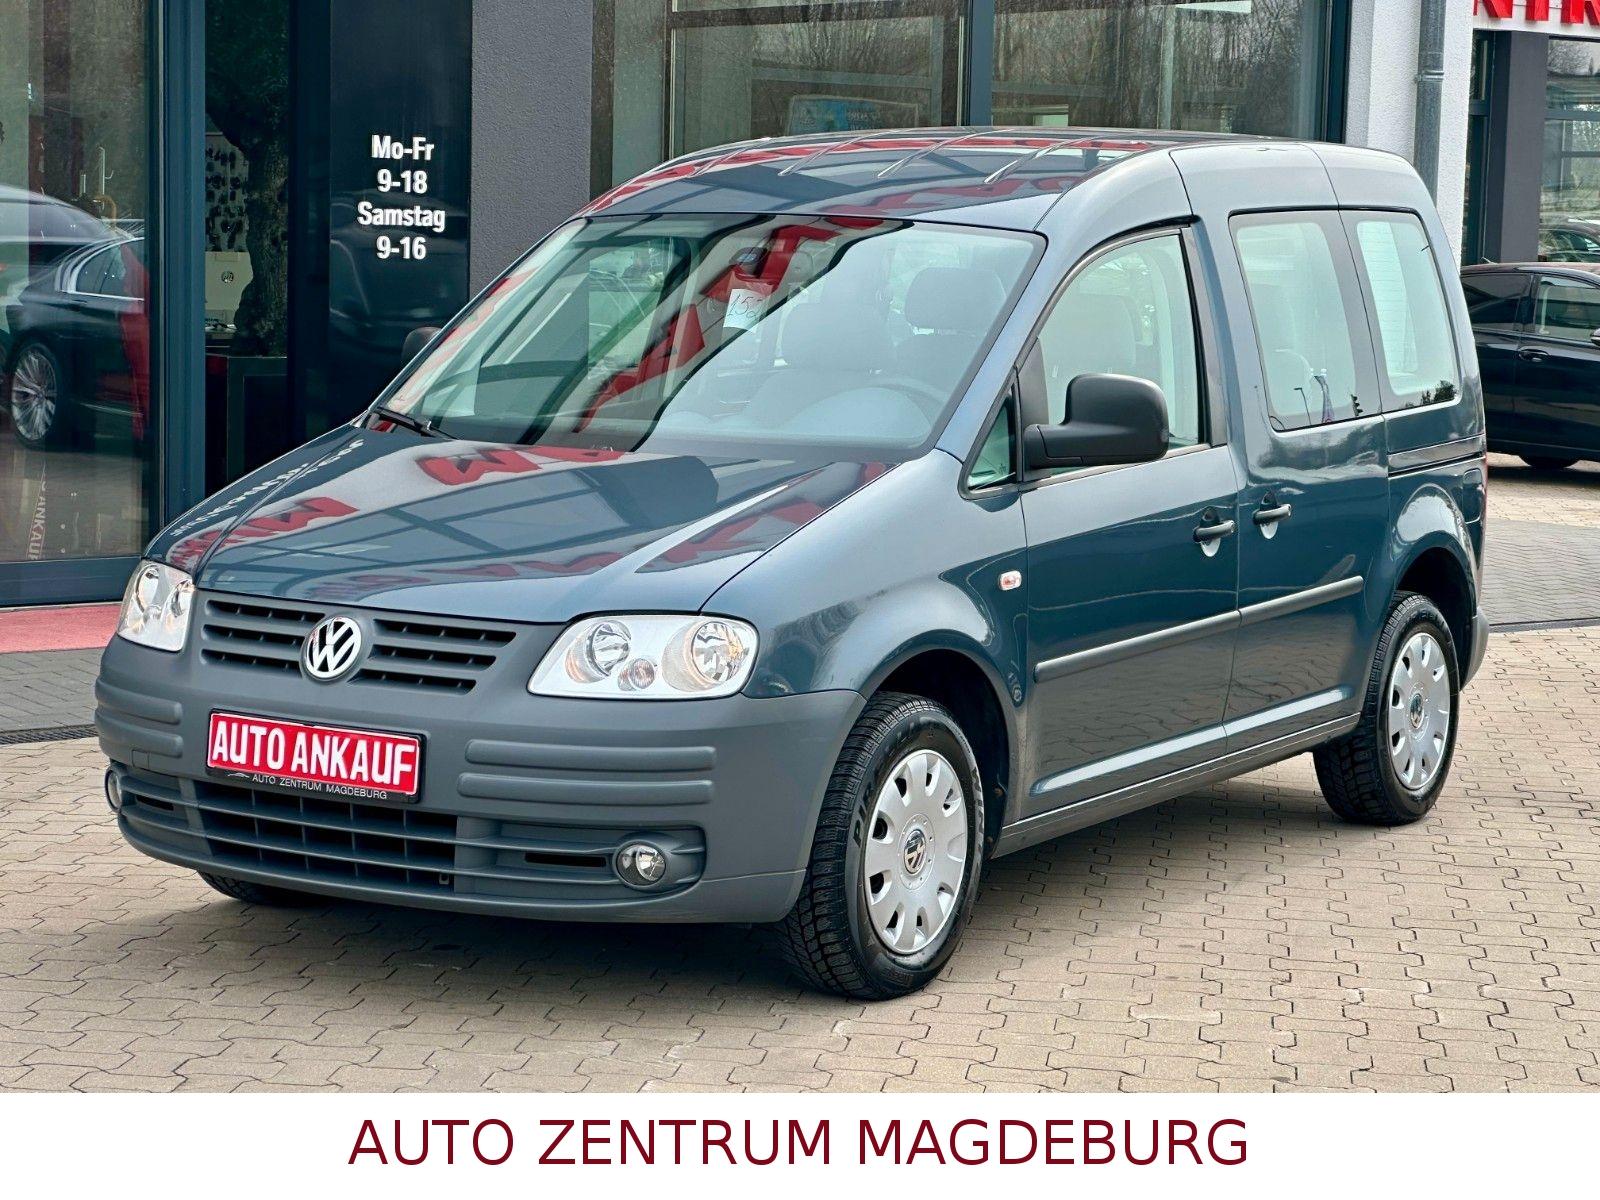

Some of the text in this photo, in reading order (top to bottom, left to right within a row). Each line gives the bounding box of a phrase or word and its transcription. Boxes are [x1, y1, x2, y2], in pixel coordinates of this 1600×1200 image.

[371, 134, 435, 161] Mo-Fr
[377, 168, 428, 194] 9-18
[357, 201, 446, 233] Samstag
[376, 235, 427, 260] 9-16
[212, 720, 416, 786] AUTO ANKAUF
[252, 774, 388, 799] AUTO ZENTRUM MAGDEBURG
